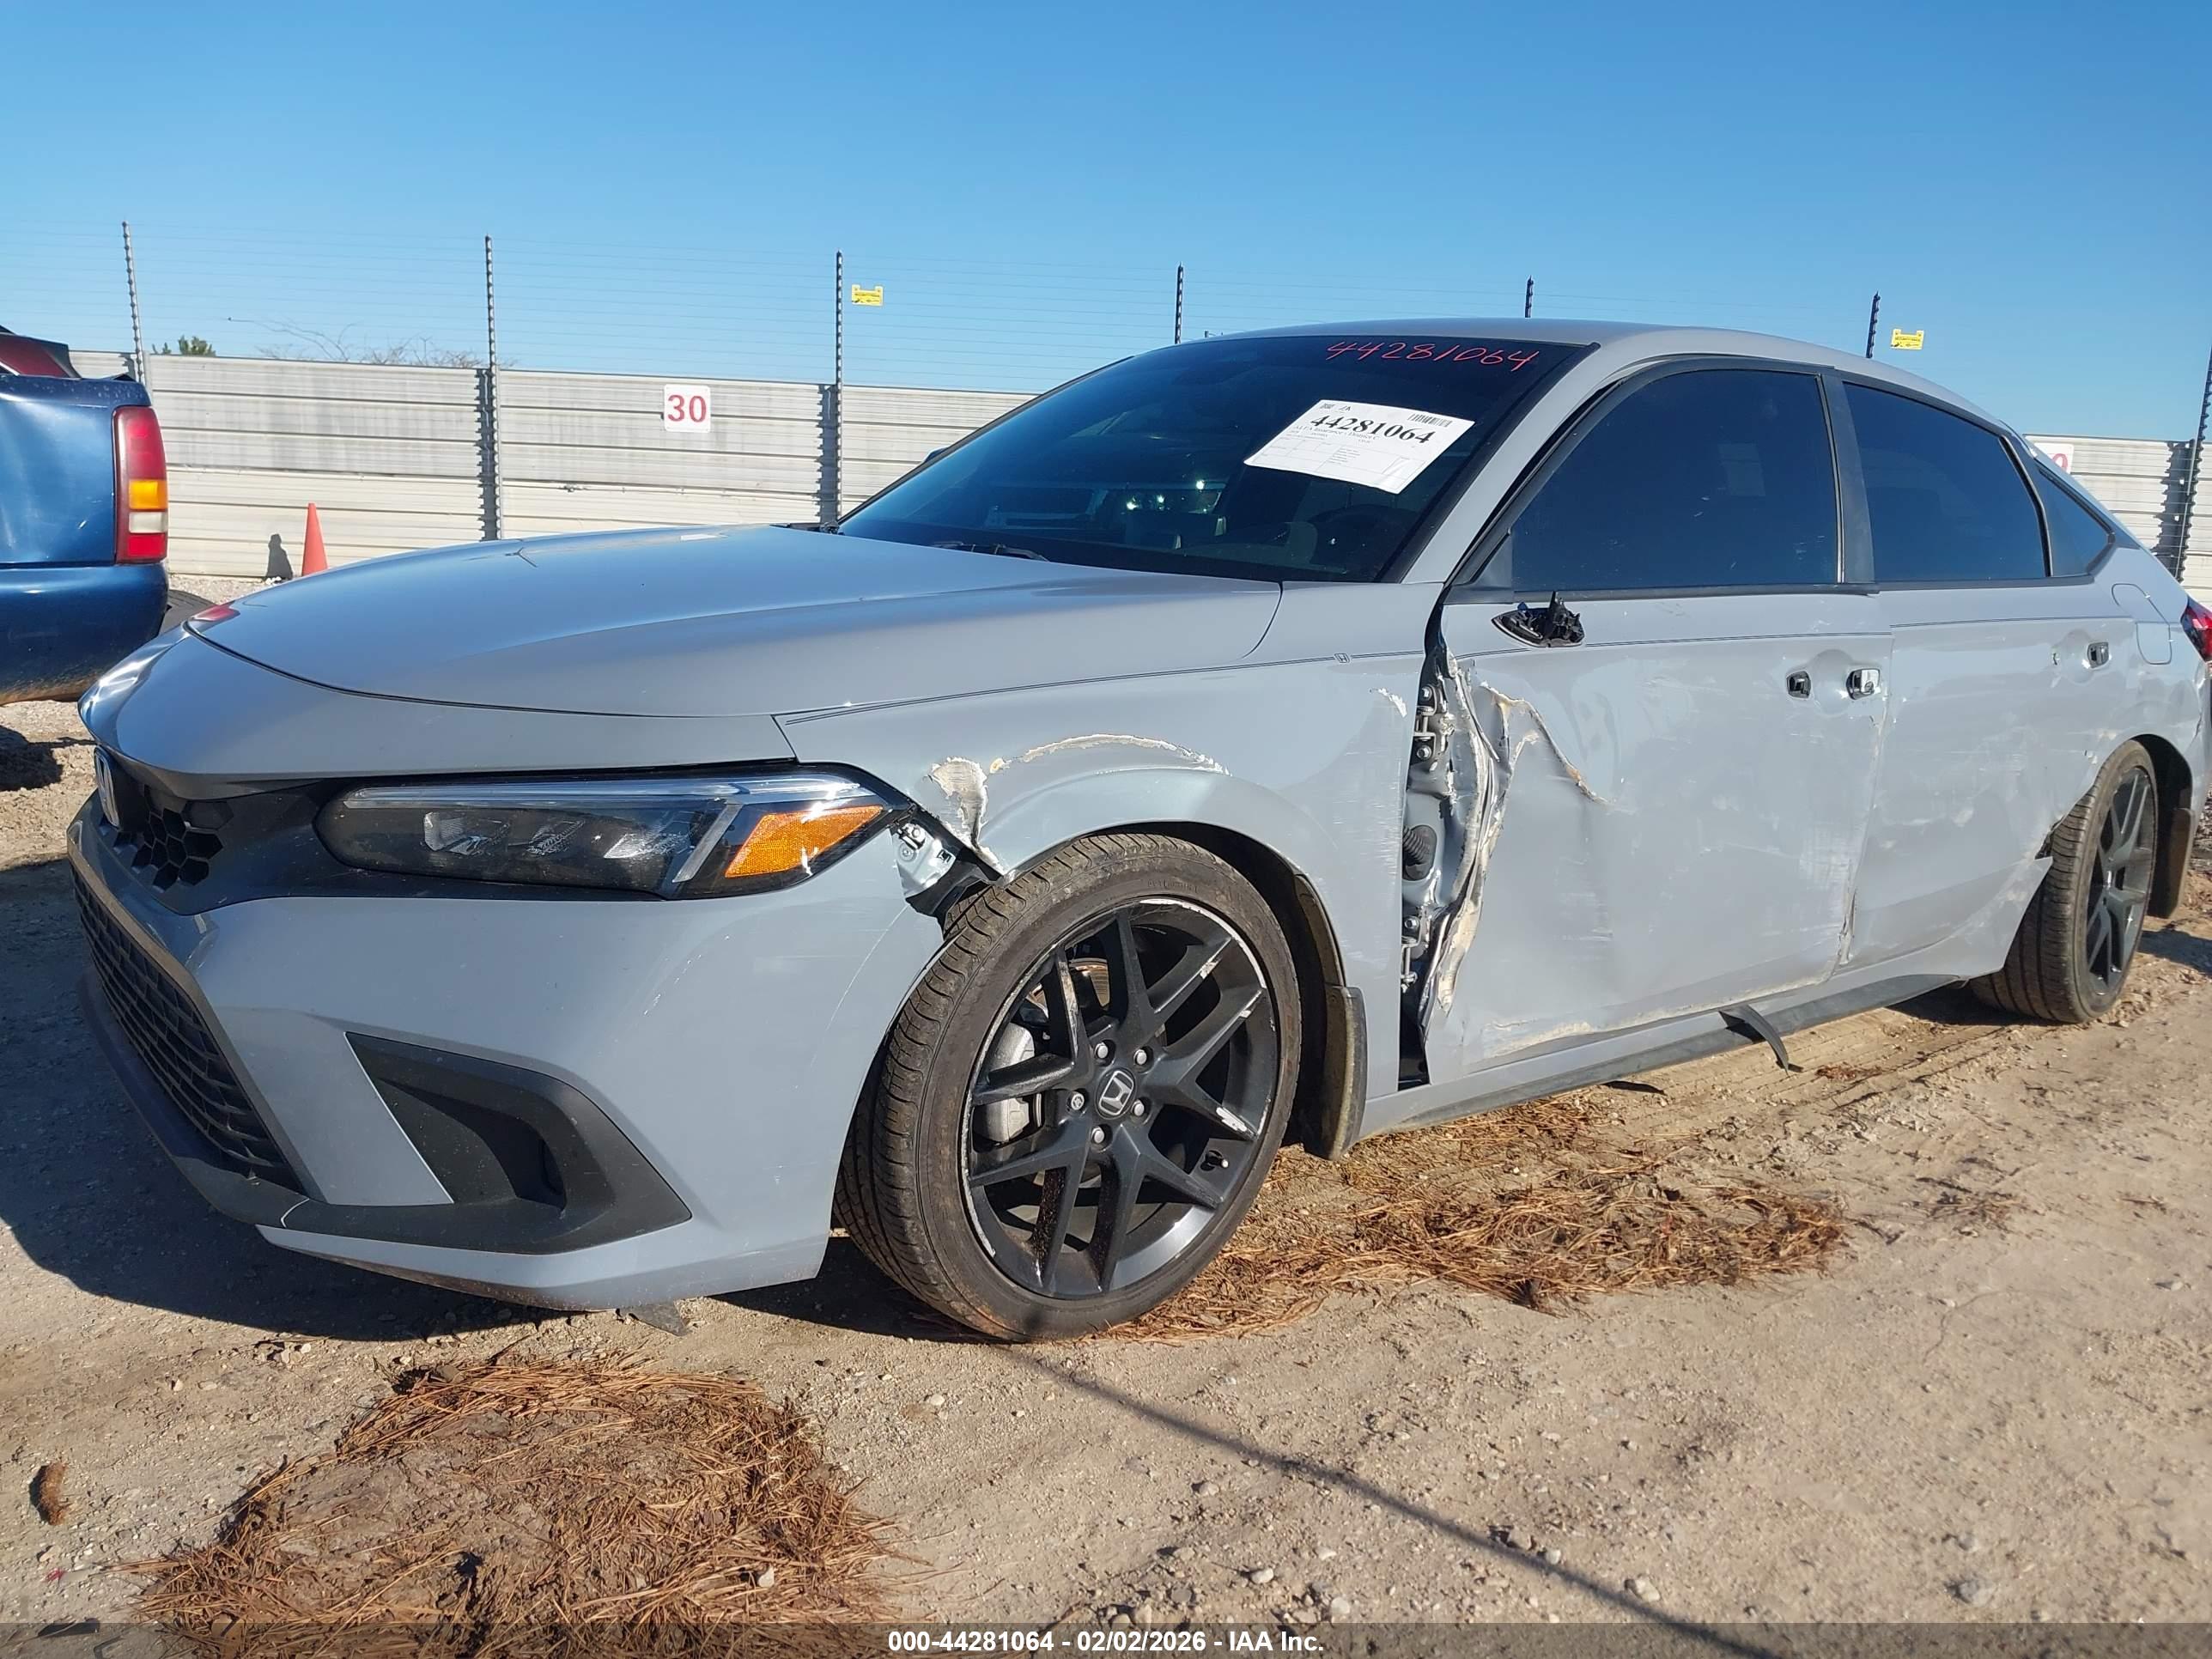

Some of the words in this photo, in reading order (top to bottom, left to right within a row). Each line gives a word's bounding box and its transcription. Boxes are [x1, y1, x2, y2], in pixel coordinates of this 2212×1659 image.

[1325, 341, 1539, 372] 44281064
[667, 394, 707, 423] 30
[1310, 414, 1437, 444] 44281064
